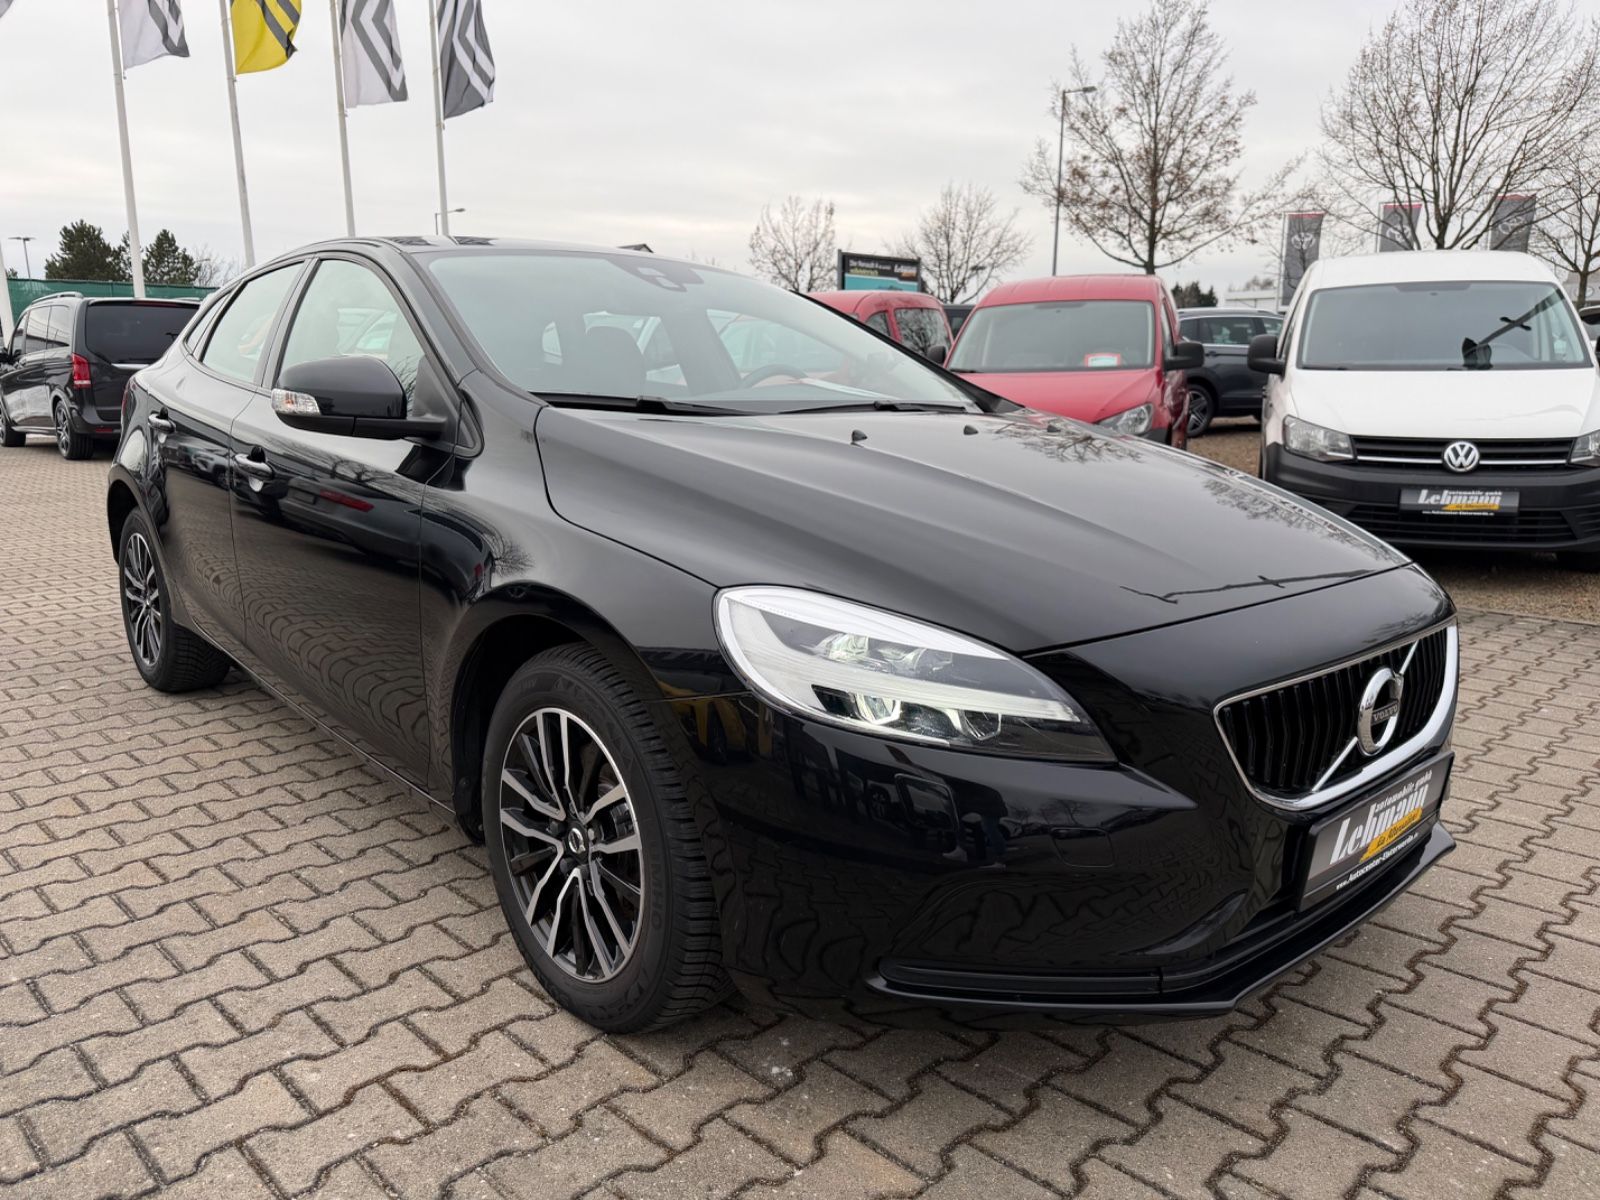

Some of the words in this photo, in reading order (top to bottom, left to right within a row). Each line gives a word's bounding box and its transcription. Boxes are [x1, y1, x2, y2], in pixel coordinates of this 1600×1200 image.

[1418, 489, 1502, 505] Lehmann
[1373, 705, 1398, 722] VOLVO
[1329, 783, 1430, 865] Lehmann
